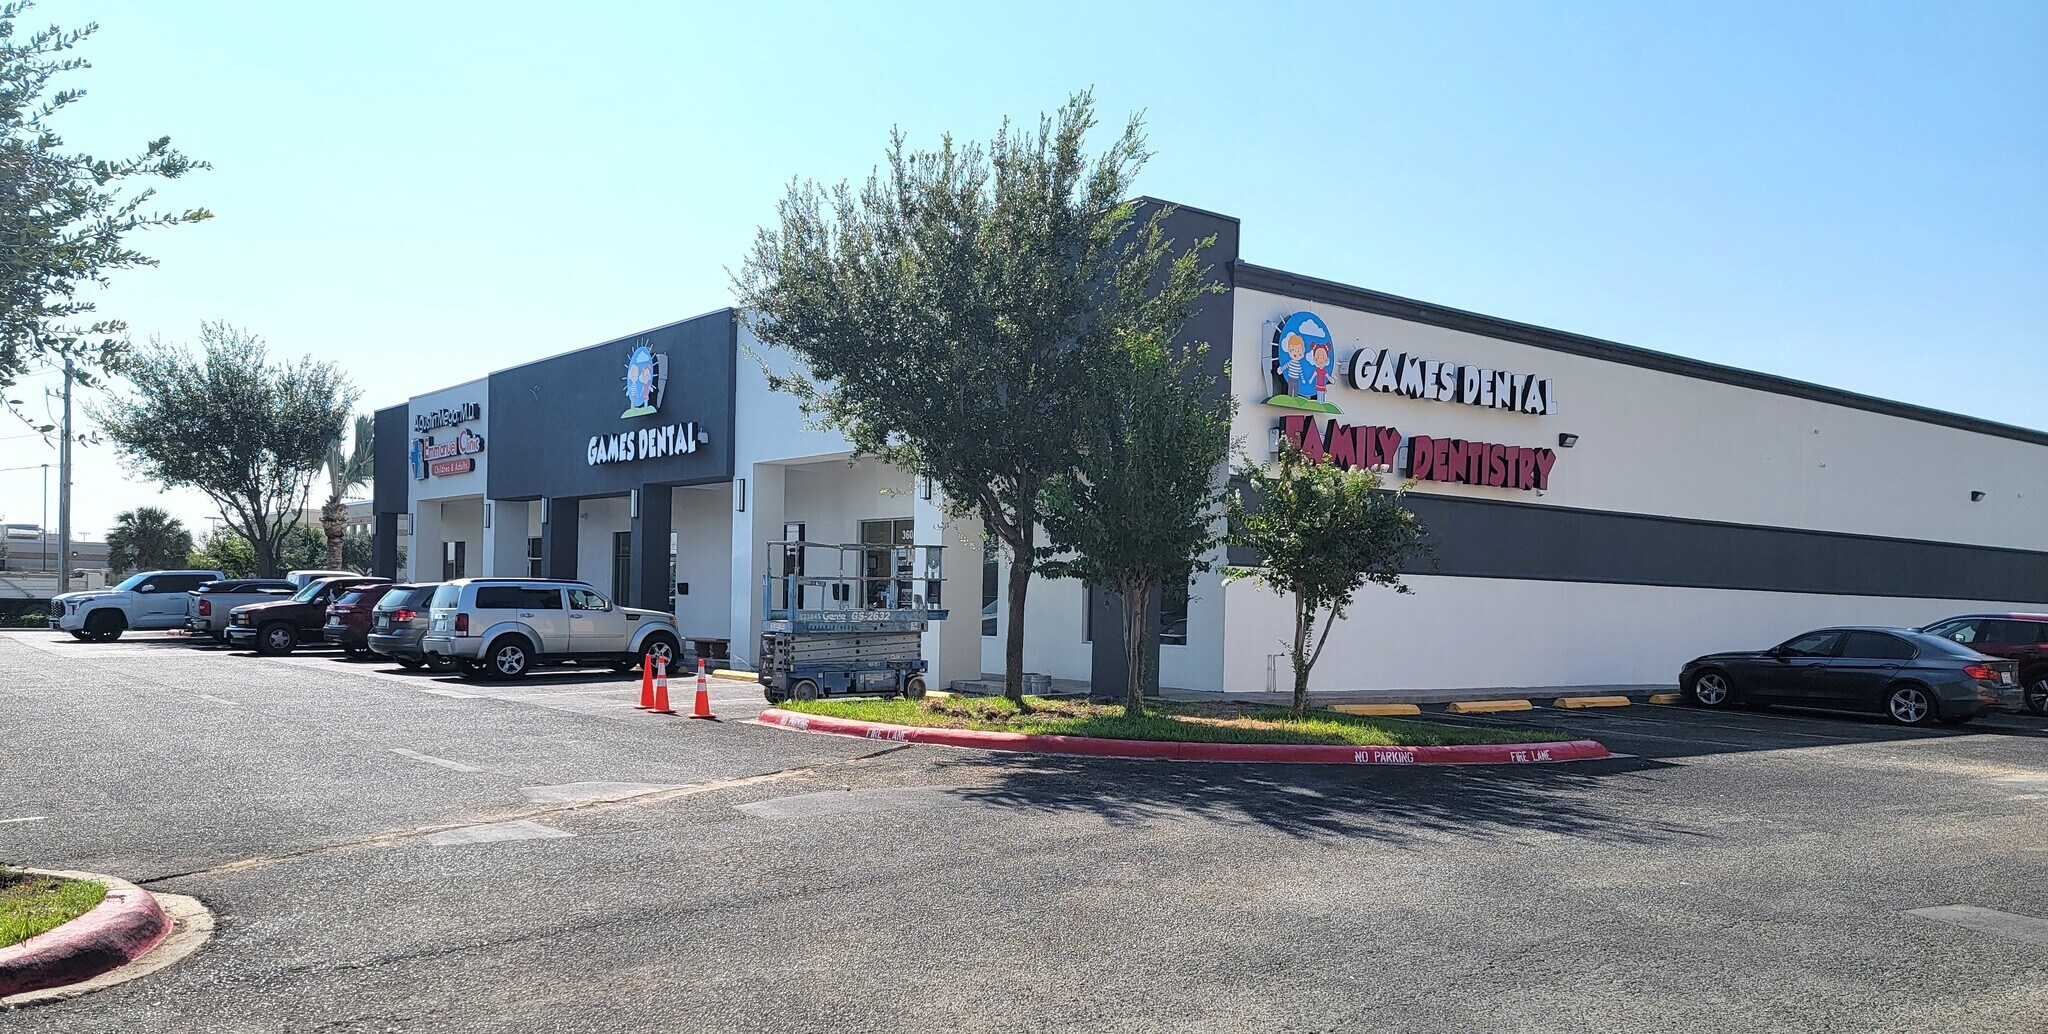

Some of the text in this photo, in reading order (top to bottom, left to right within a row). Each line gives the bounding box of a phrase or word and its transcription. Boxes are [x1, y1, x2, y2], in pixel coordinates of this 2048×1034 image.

[1351, 347, 1558, 416] GAMES DENTAL
[423, 428, 481, 461] Emmanuel Clinic
[587, 421, 696, 466] GAMES DENTAL
[1283, 414, 1557, 491] FAMILY DENTISTRY
[822, 611, 847, 621] Genie
[866, 727, 907, 742] FIRE LANE
[1354, 750, 1414, 763] NO PARKING
[1510, 749, 1552, 763] FIRE LANE
